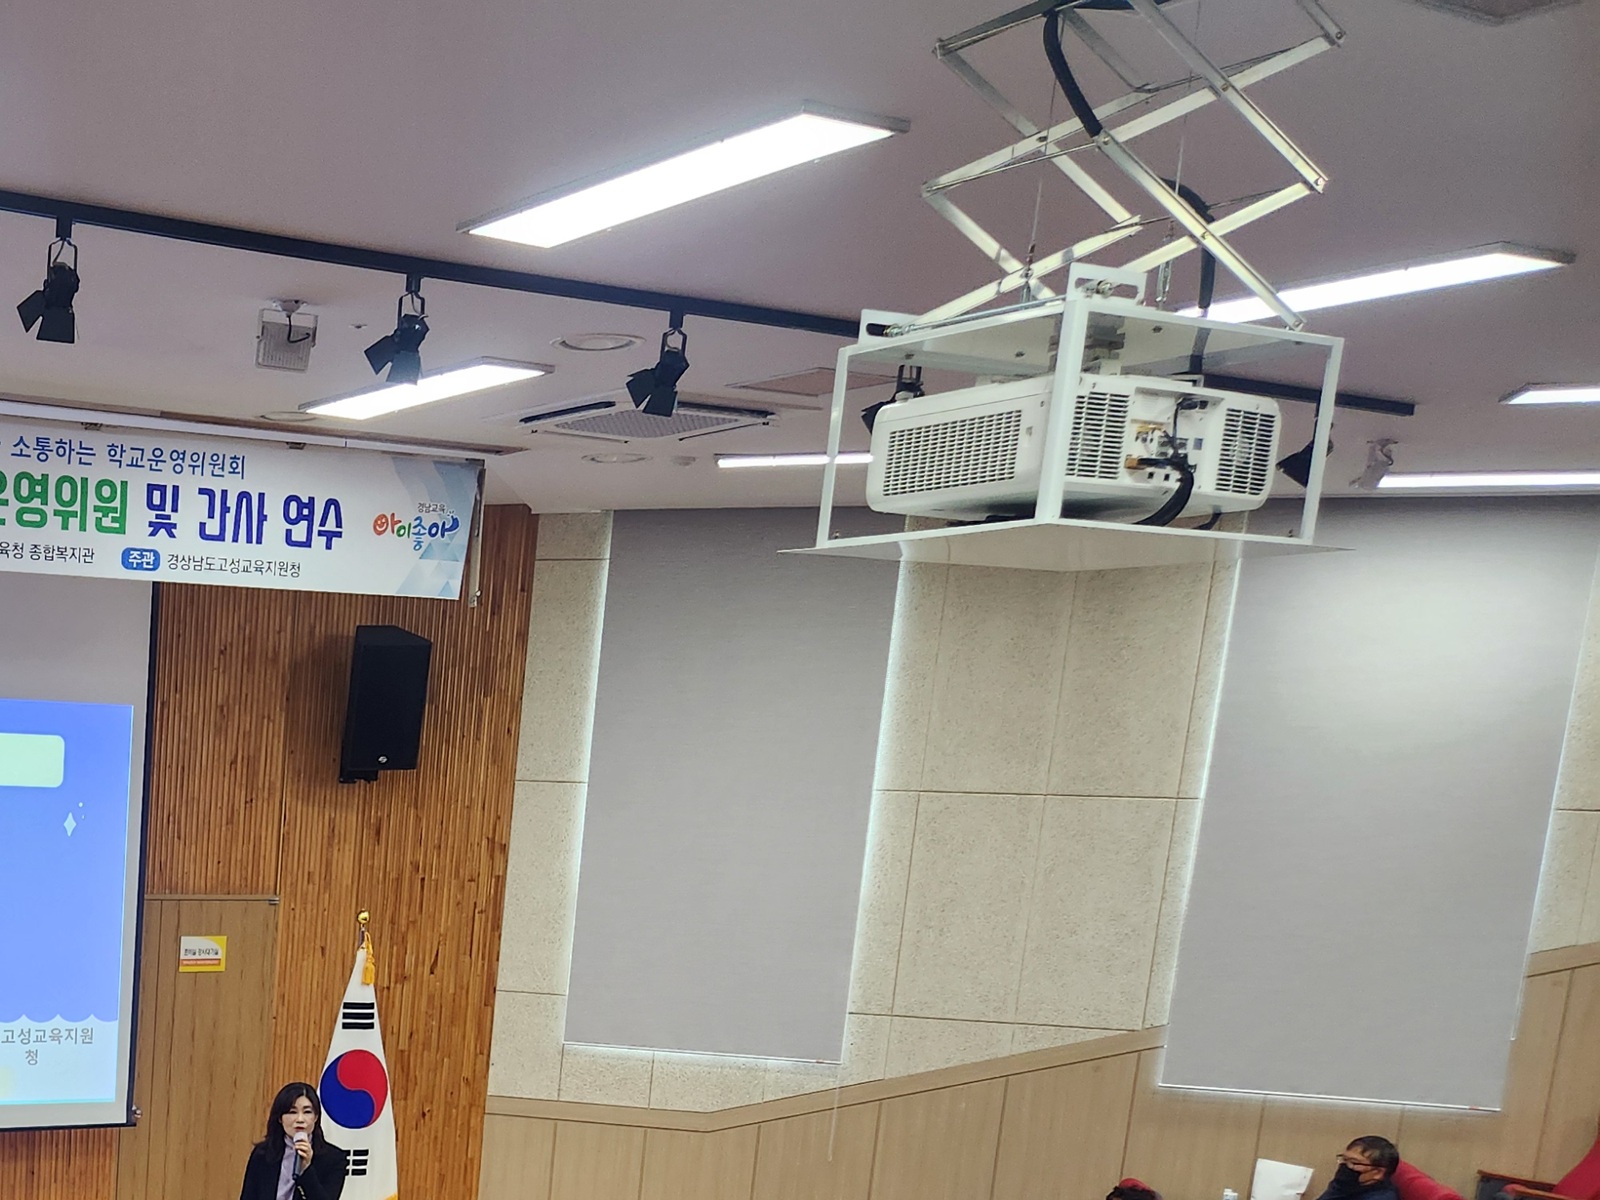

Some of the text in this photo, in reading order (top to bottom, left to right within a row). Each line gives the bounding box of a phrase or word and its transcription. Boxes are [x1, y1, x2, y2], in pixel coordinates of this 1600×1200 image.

[11, 435, 97, 466] 소통하는
[107, 443, 246, 480] 학교운영위원회
[146, 483, 180, 539] 및
[198, 487, 268, 545] 간사
[283, 494, 344, 551] 연수
[417, 502, 447, 514] 경남교육
[372, 512, 460, 552] 아이좋아
[29, 544, 96, 564] 종합복지관
[128, 551, 156, 569] 주관
[167, 553, 301, 578] 경상남도고성교육지원청
[24, 1049, 39, 1066] 청
